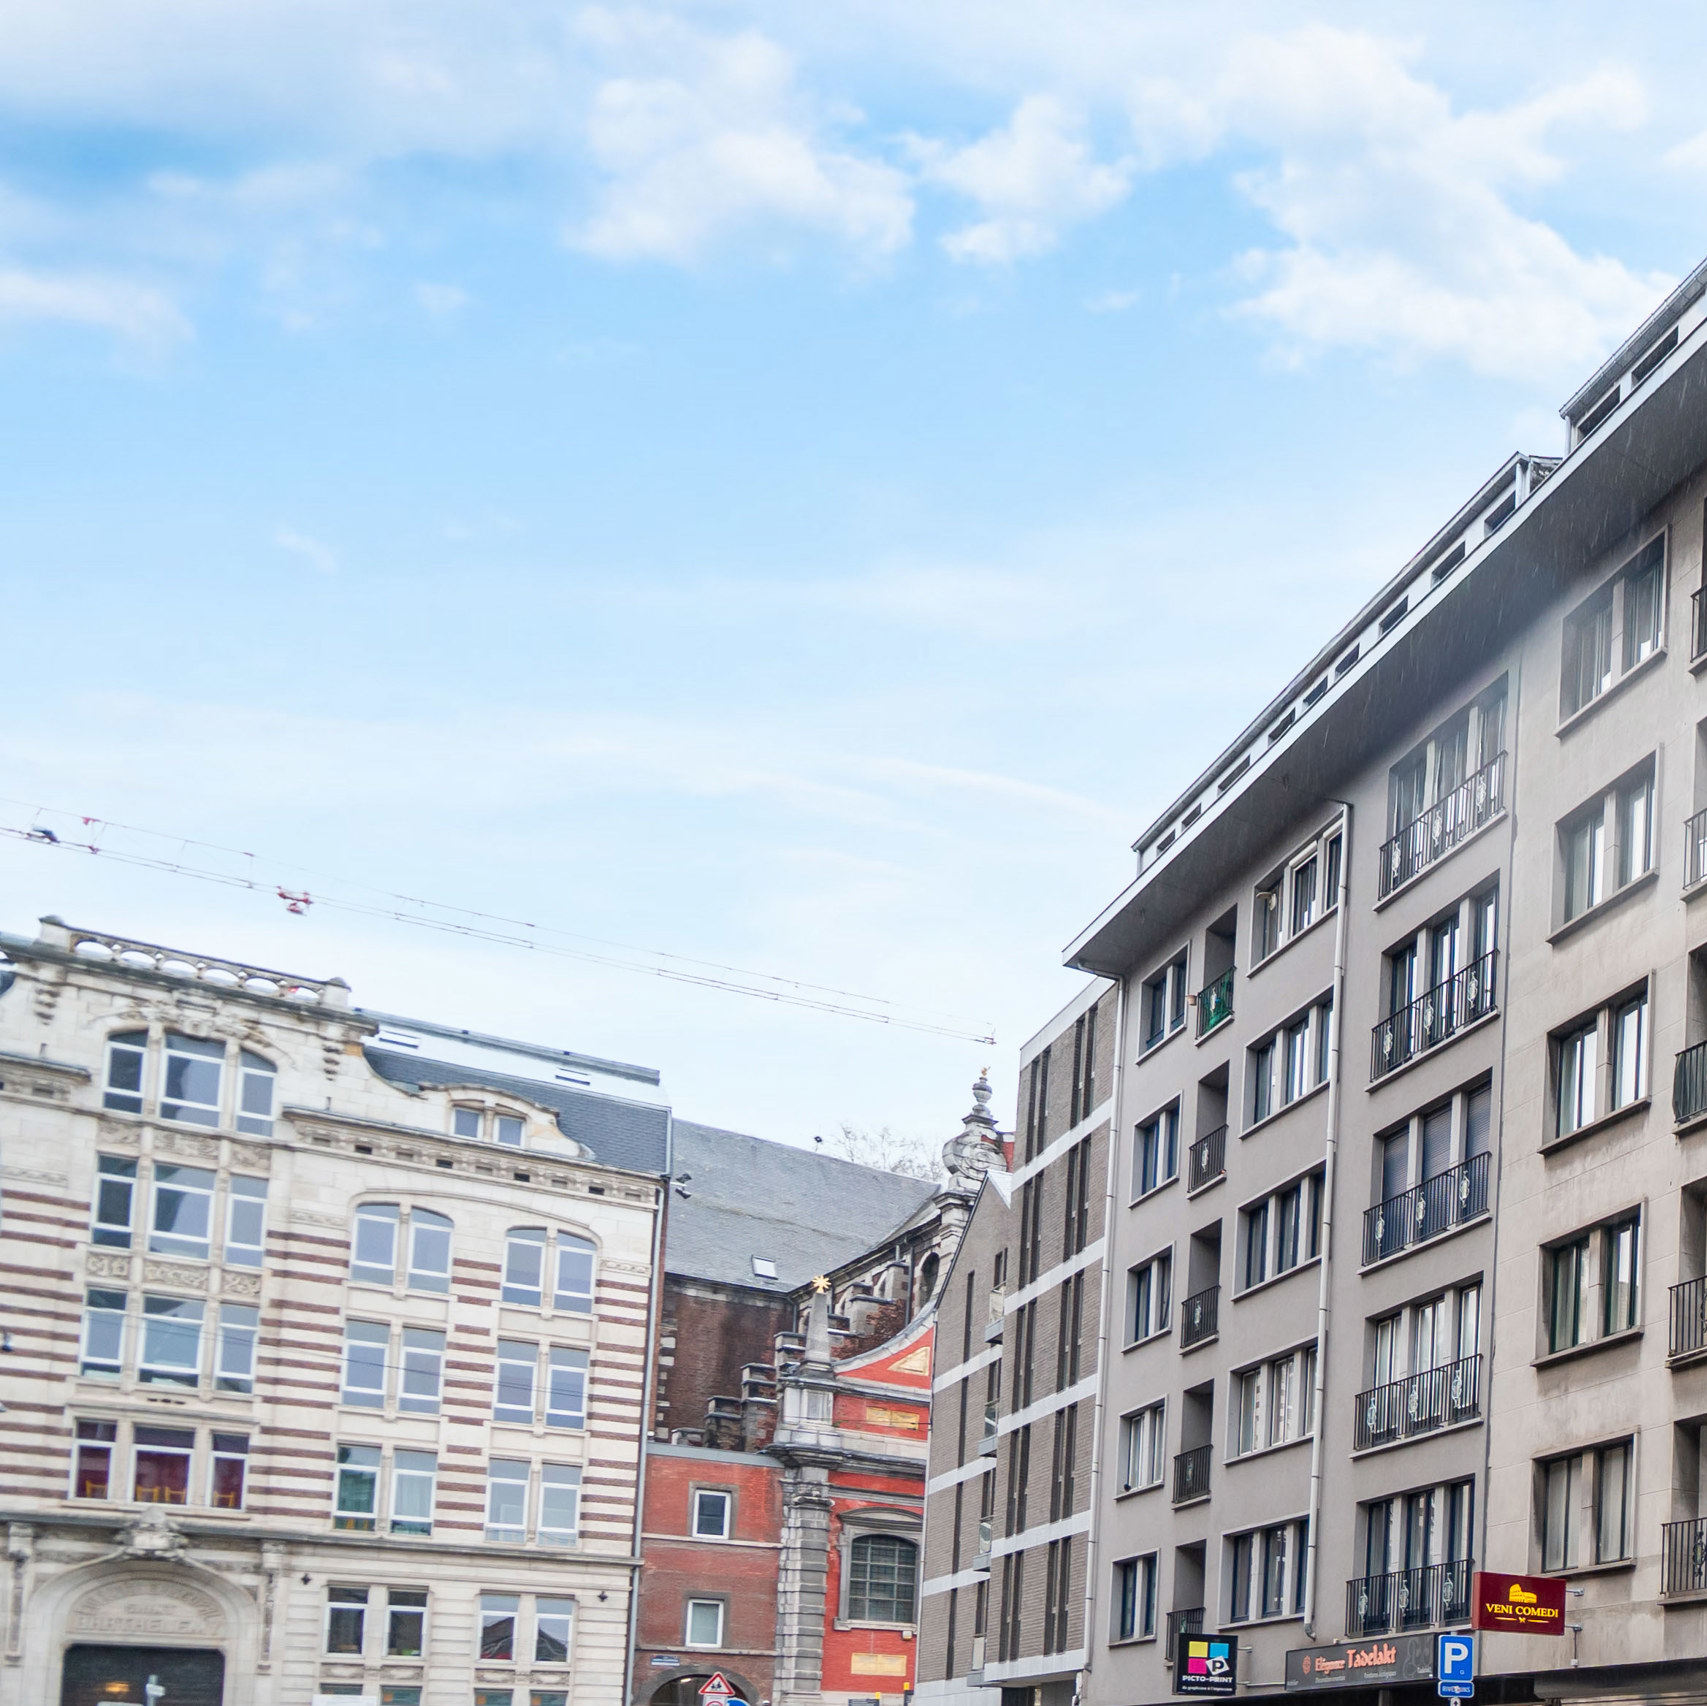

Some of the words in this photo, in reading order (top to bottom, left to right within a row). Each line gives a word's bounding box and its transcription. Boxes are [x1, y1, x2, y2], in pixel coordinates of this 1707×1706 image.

[1485, 1603, 1513, 1615] VENI
[1515, 1606, 1559, 1618] COMEDI
[1346, 1643, 1397, 1668] Tadelakt
[1444, 1642, 1469, 1674] P
[1182, 1675, 1233, 1683] PICTO-PRINT
